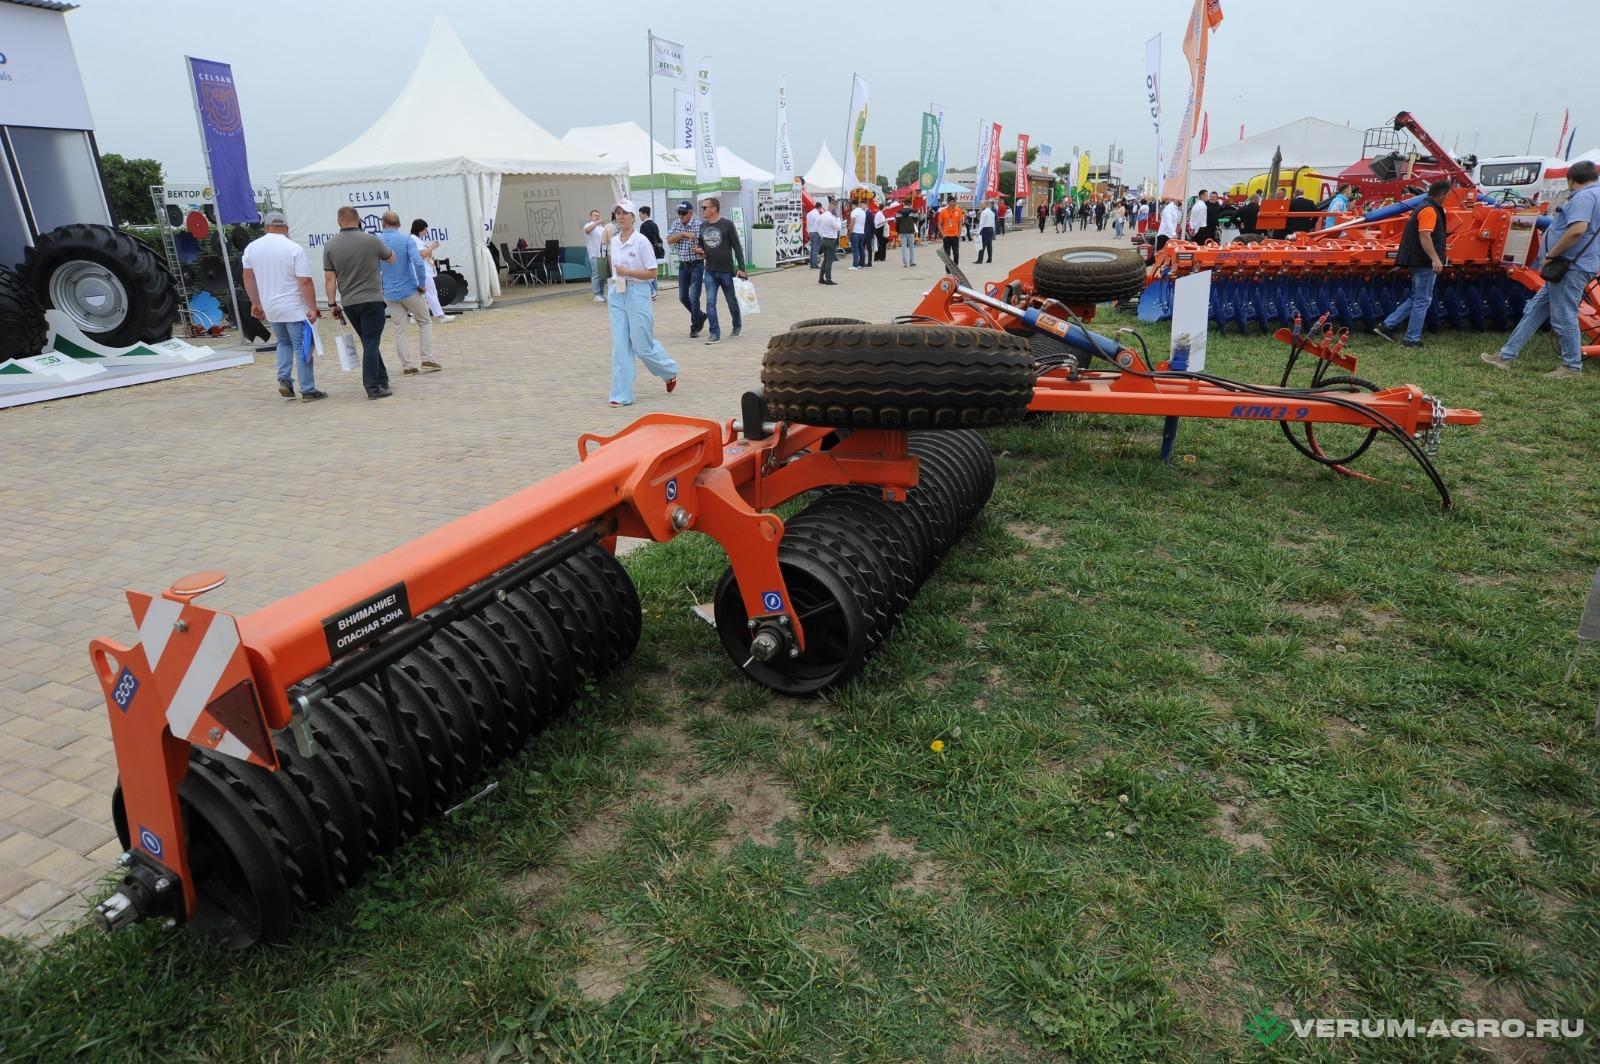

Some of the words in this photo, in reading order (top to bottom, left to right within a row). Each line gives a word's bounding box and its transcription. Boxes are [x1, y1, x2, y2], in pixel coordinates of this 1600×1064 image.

[199, 73, 231, 84] CELSAN
[167, 190, 201, 198] ВЕКТОР
[348, 190, 390, 202] CELSAN
[420, 227, 449, 241] АПЫ
[337, 594, 397, 631] ВНИМАНИЕ!
[336, 620, 380, 648] ОПАСНАЯ
[379, 608, 404, 626] ЗОНА
